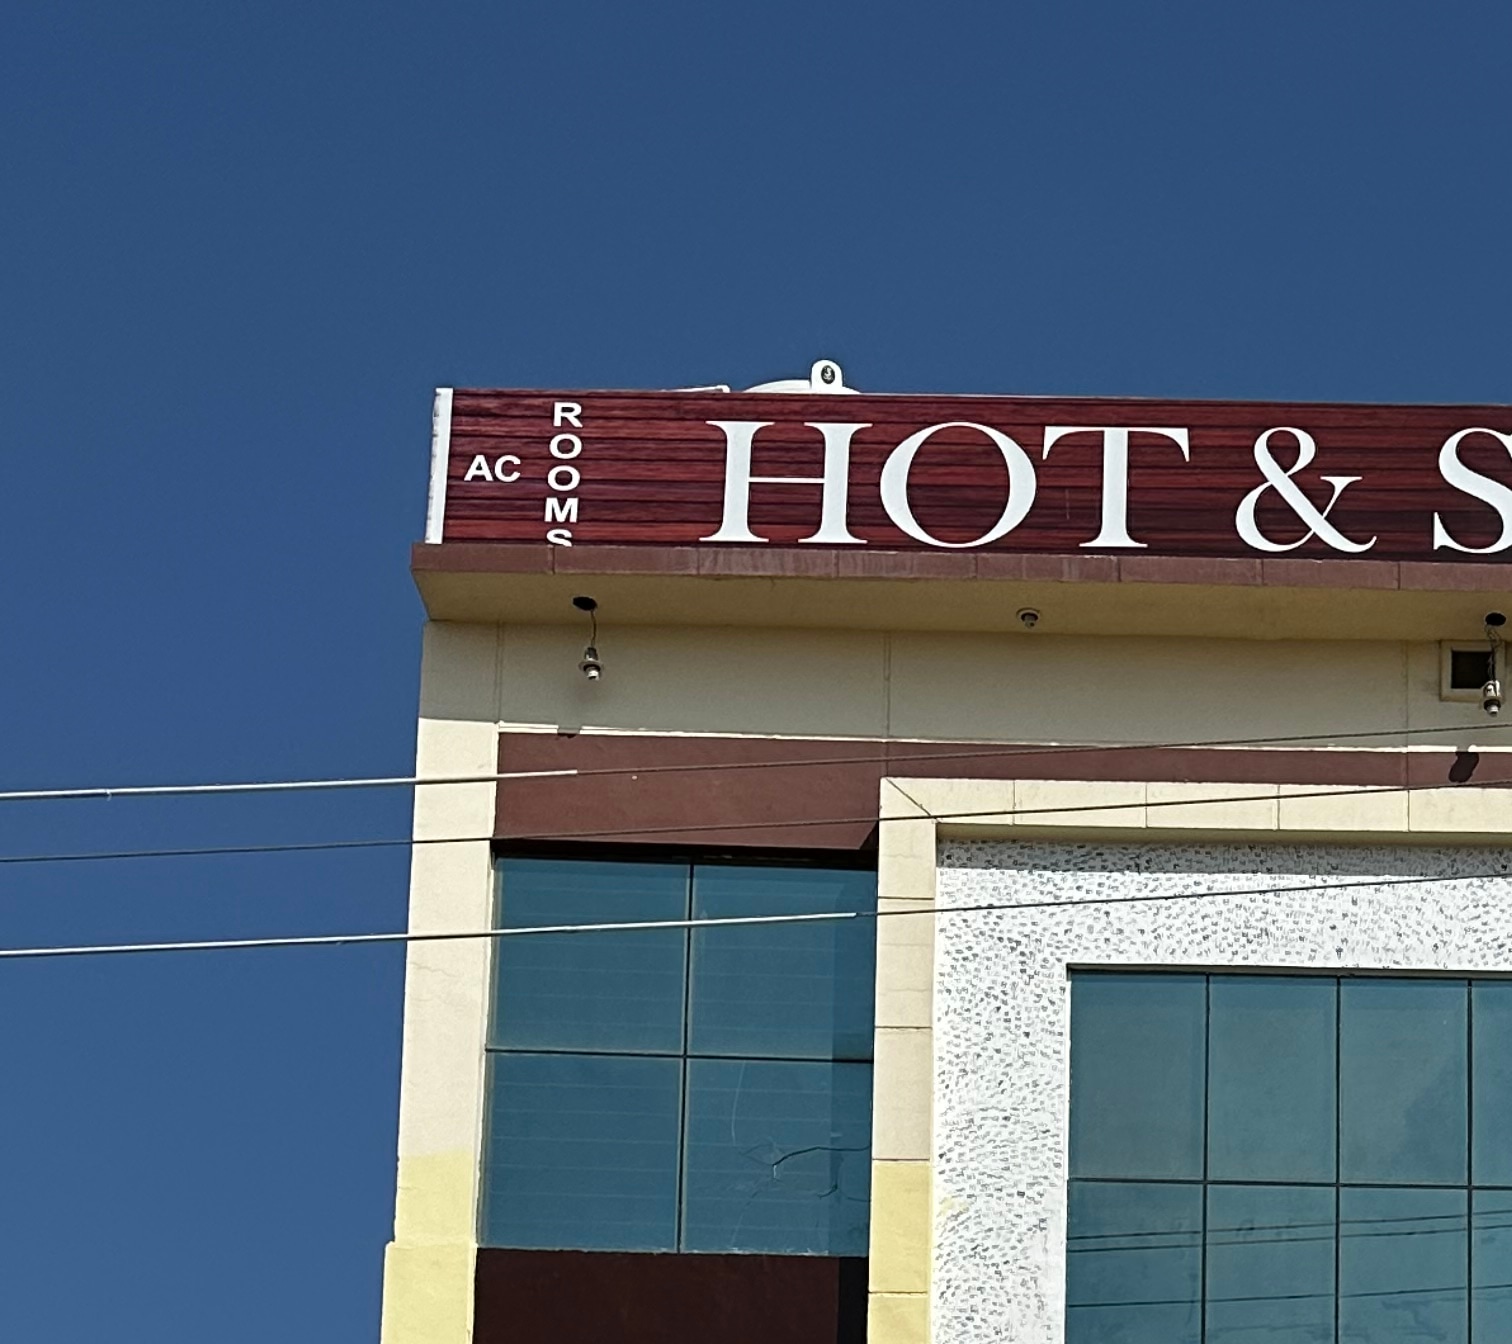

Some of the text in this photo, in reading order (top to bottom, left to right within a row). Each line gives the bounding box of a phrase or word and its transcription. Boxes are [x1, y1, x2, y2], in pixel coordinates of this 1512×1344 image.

[464, 455, 521, 482] AC
[544, 402, 583, 547] ROOMS
[699, 420, 1190, 548] HOT
[1235, 427, 1377, 552] &
